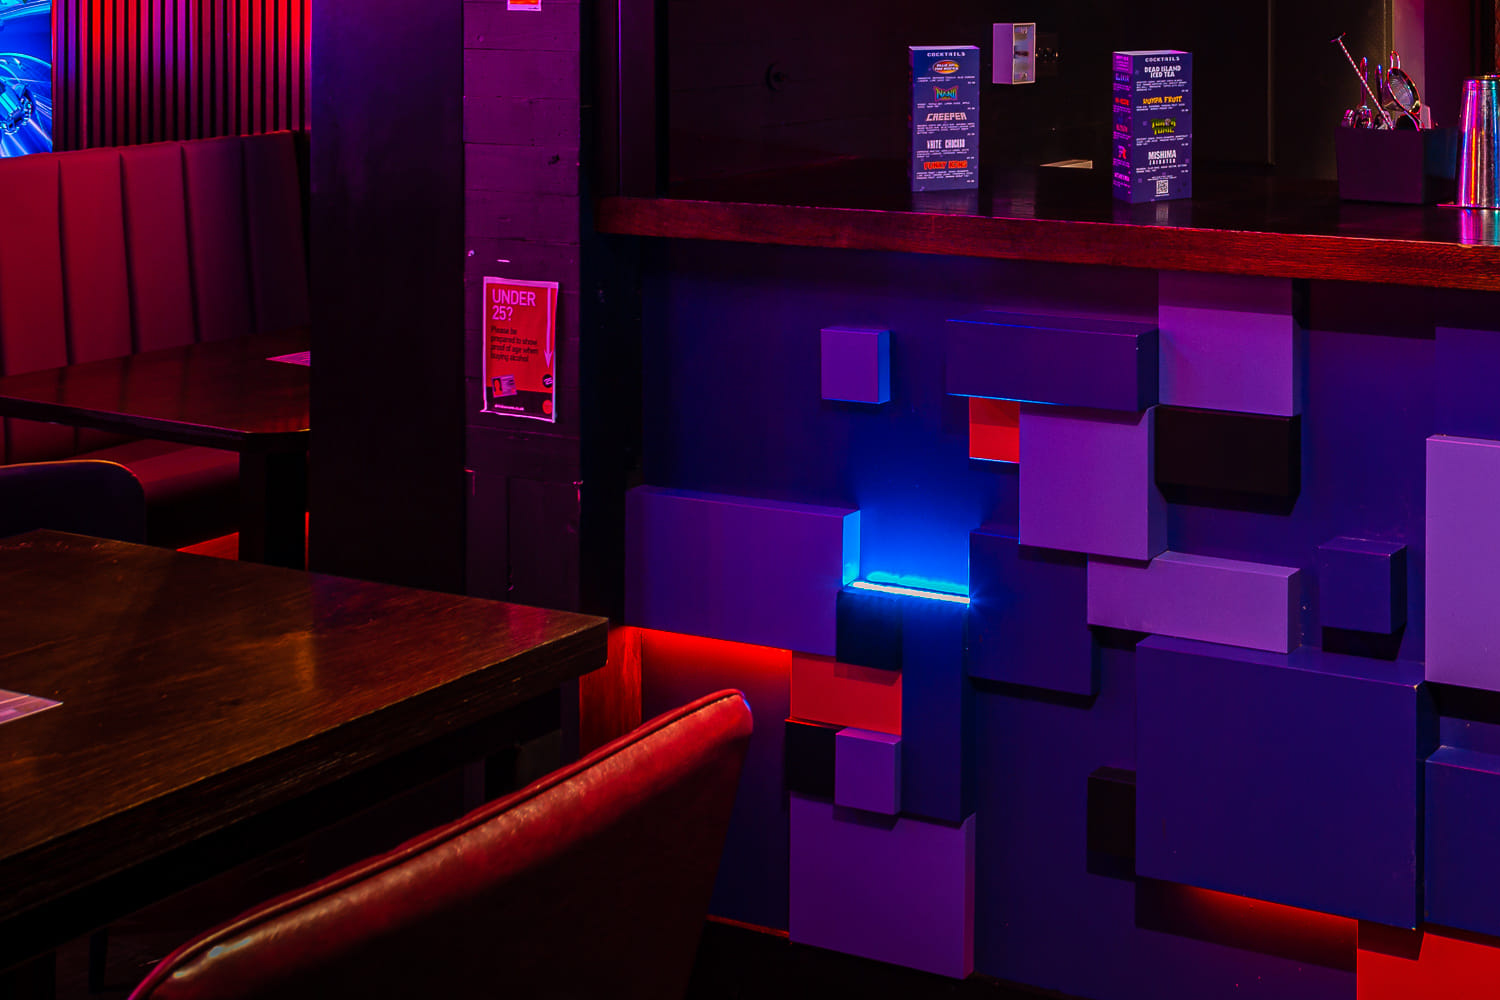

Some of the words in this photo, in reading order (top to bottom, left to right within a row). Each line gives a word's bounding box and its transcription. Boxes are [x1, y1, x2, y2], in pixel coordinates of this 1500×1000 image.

[926, 112, 967, 121] CREEPER
[1148, 150, 1177, 159] MISHIMA
[492, 288, 536, 307] UNDER
[492, 305, 513, 321] 25?
[490, 325, 509, 334] Please
[510, 327, 517, 335] be
[490, 336, 515, 345] prepared
[490, 353, 509, 362] buying
[510, 354, 529, 362] alcohol
